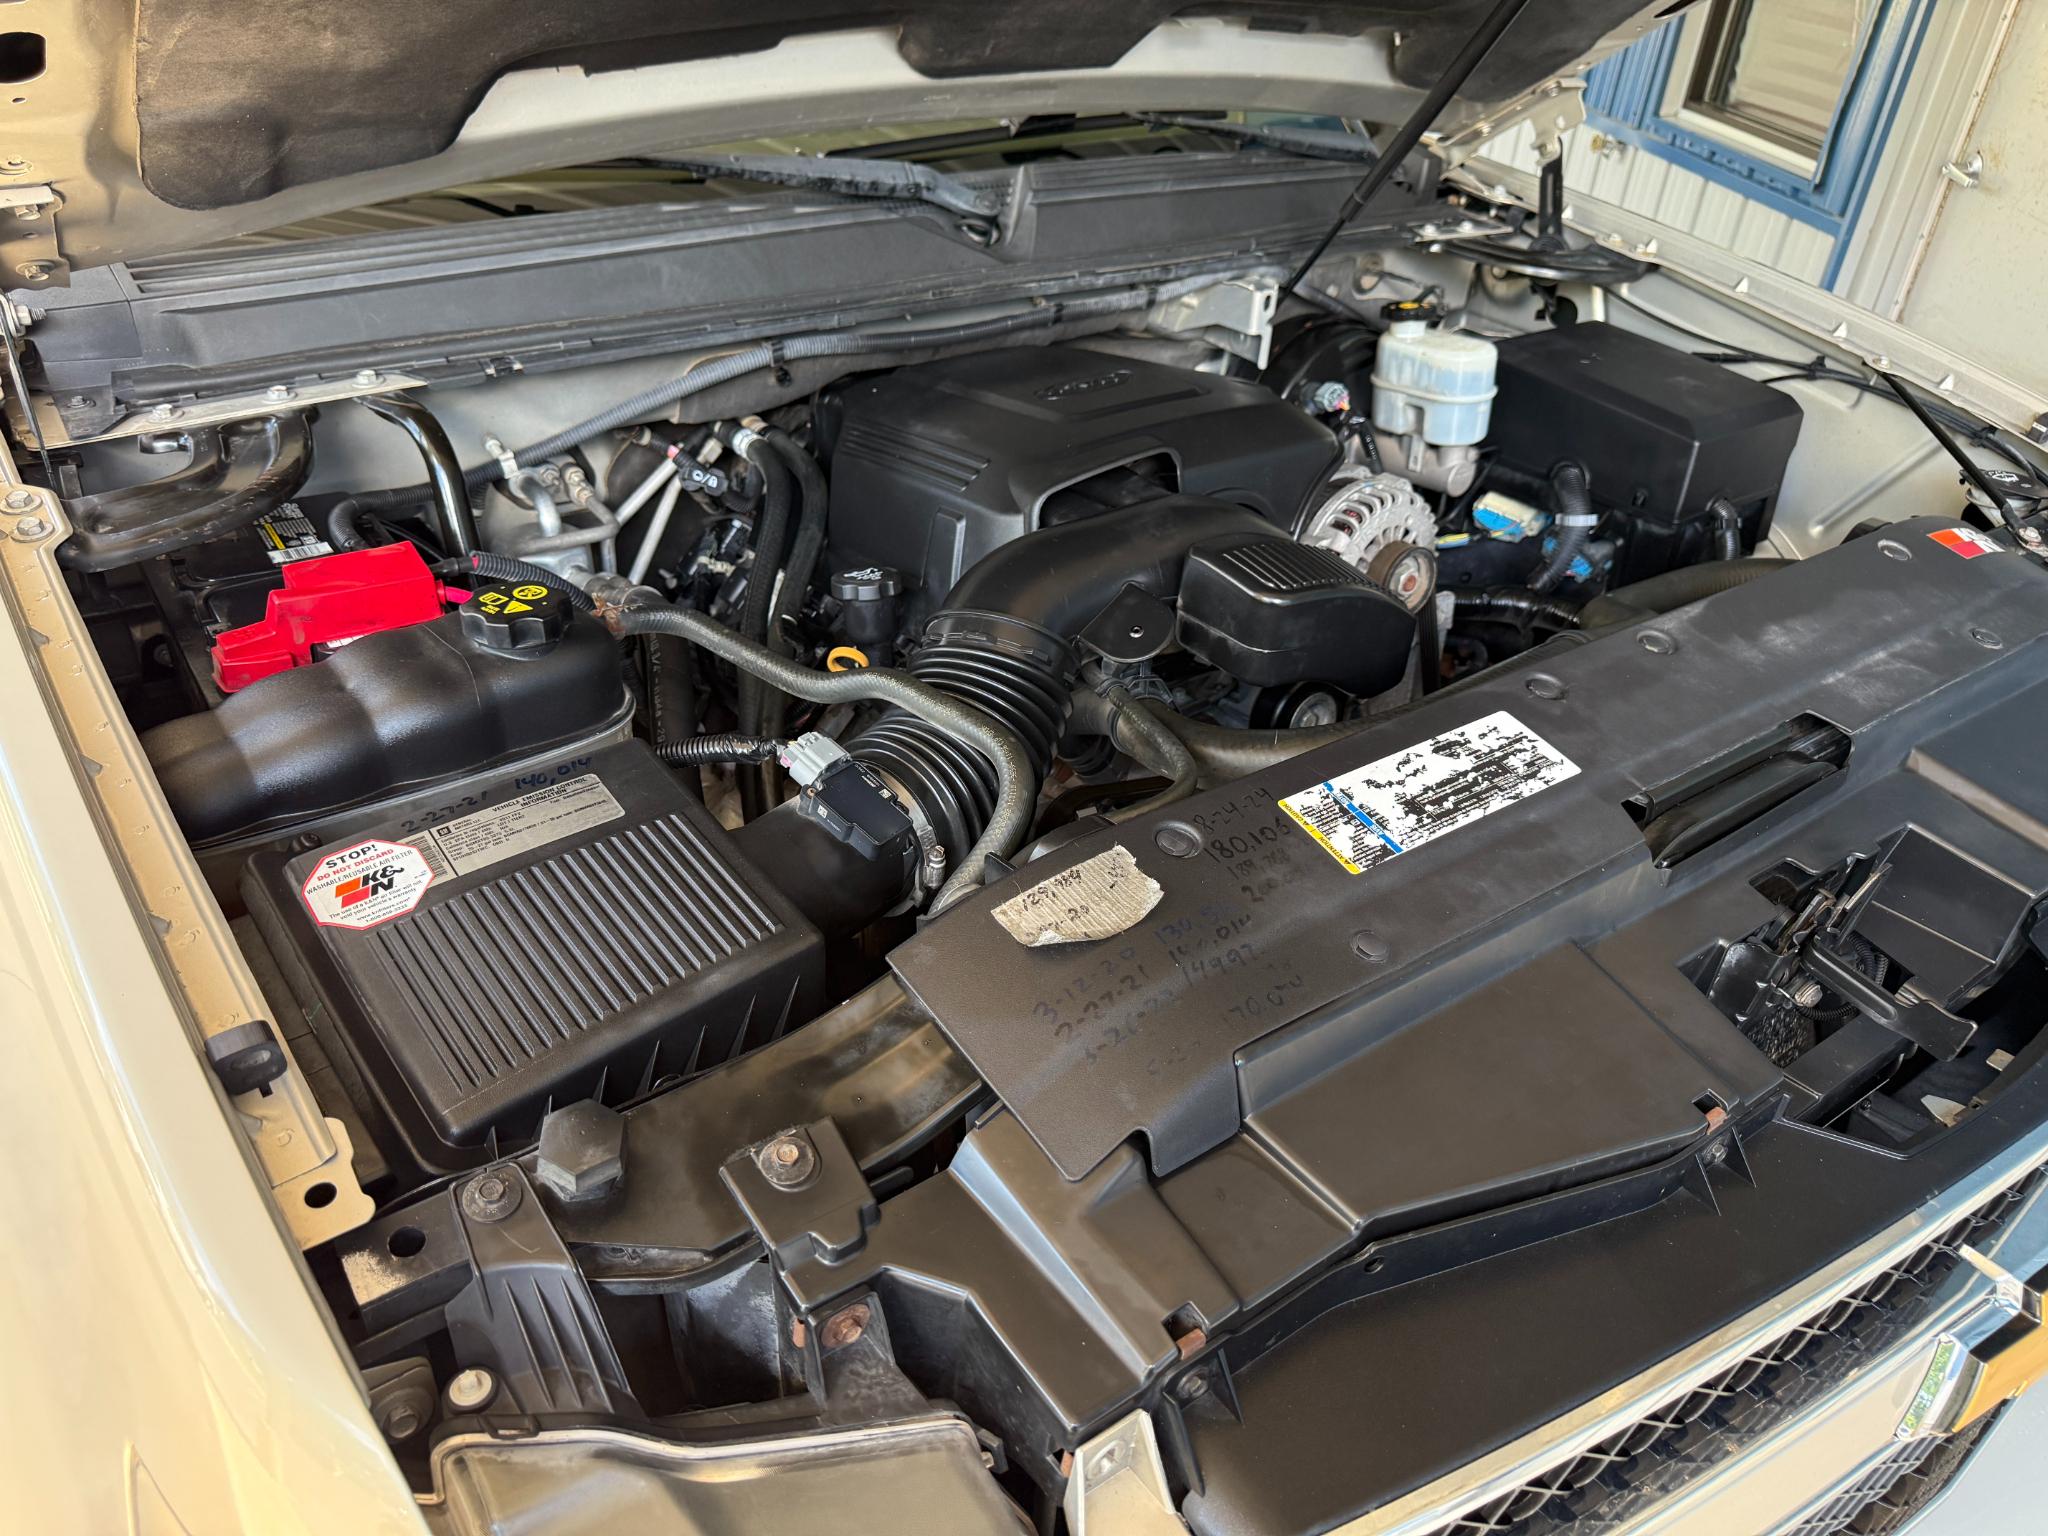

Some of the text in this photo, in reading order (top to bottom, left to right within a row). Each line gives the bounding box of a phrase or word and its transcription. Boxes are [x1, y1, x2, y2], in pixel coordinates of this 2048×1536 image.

[514, 756, 593, 789] 140,014
[521, 786, 555, 801] EMISSION
[555, 776, 588, 791] CONTROL
[306, 850, 413, 895] WASHABLE/REUSABLE AIR FILTER
[316, 849, 394, 881] DO NOT DISCARD
[325, 844, 378, 869] STOP!
